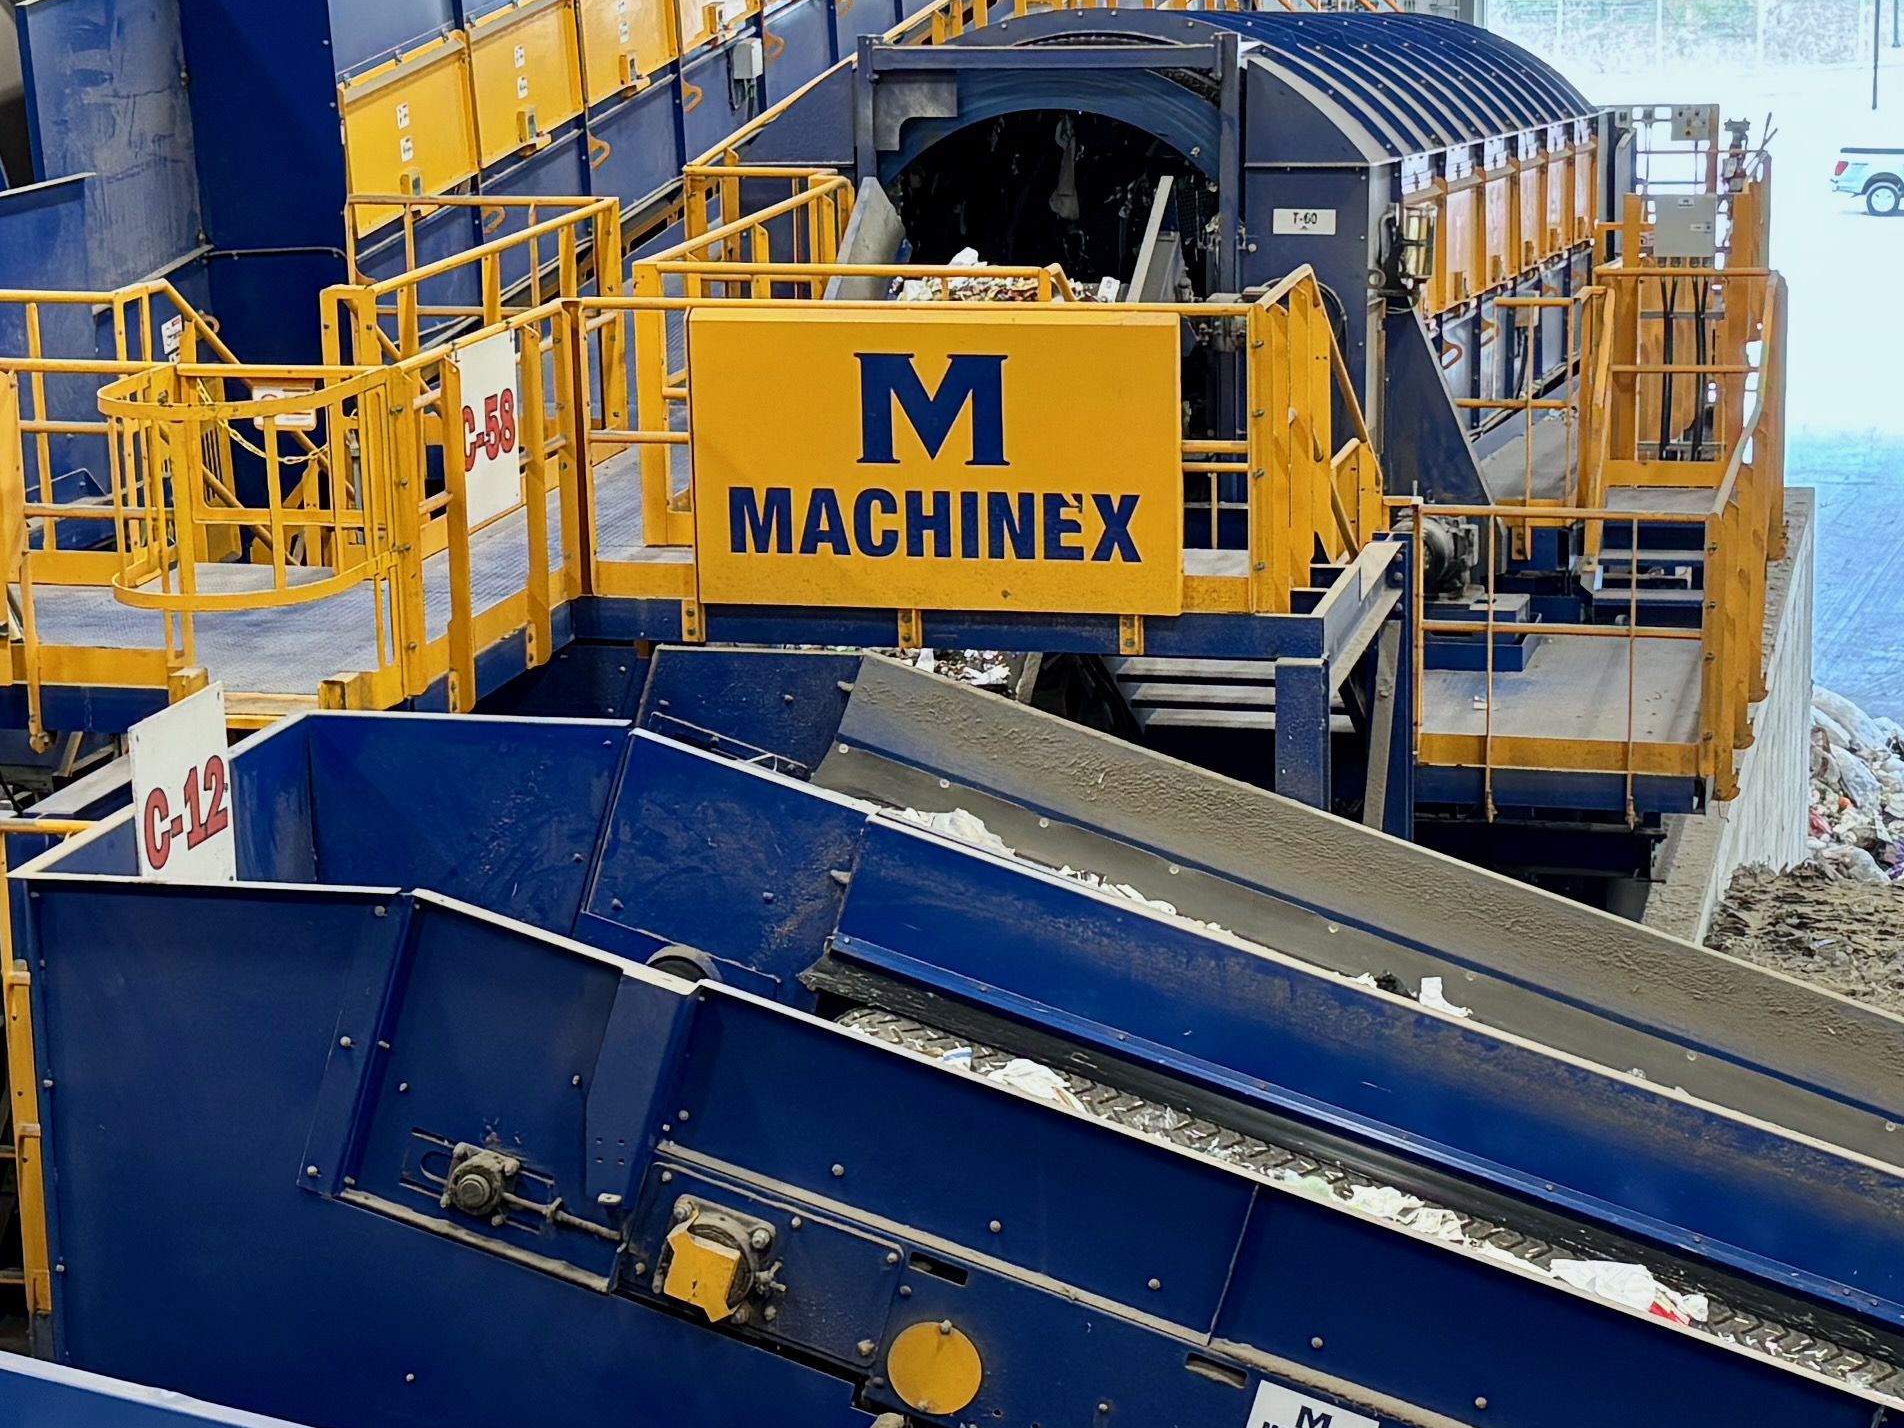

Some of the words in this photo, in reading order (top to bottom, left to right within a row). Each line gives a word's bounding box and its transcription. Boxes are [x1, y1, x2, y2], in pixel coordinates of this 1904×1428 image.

[1293, 212, 1318, 224] T-60
[462, 388, 515, 472] C-58
[853, 352, 1008, 466] M
[728, 487, 1141, 563] MACHINEX
[142, 755, 229, 871] C-12
